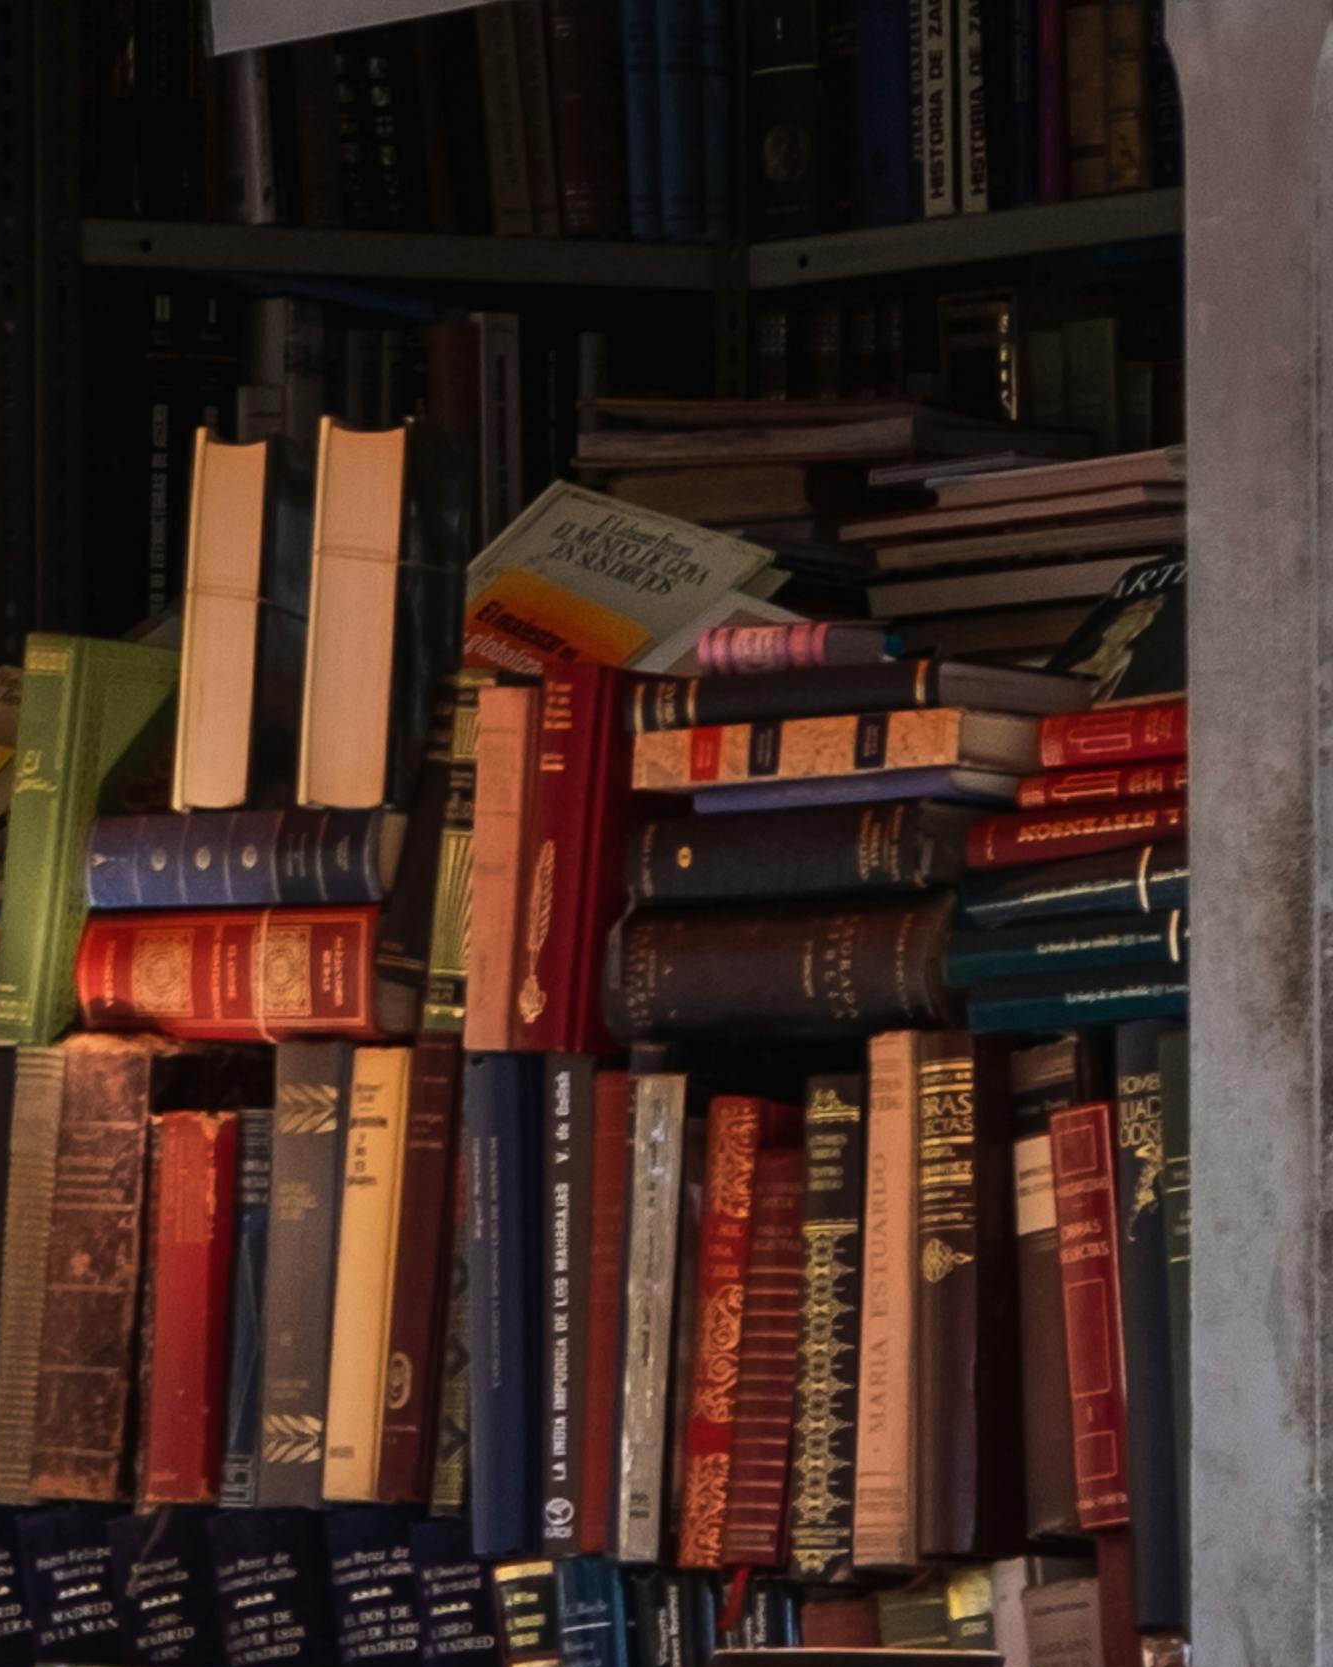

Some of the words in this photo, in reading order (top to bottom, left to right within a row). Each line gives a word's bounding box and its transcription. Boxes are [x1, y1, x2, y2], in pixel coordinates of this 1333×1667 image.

[929, 52, 944, 81] DE
[929, 90, 945, 199] HISTORIA
[970, 85, 987, 195] HISTORIA
[869, 1153, 889, 1319] ESTUARDO
[553, 1312, 569, 1332] DE
[552, 1336, 570, 1411] IMPUDICA
[867, 1335, 890, 1435] MARIA
[551, 1416, 569, 1458] INDIA
